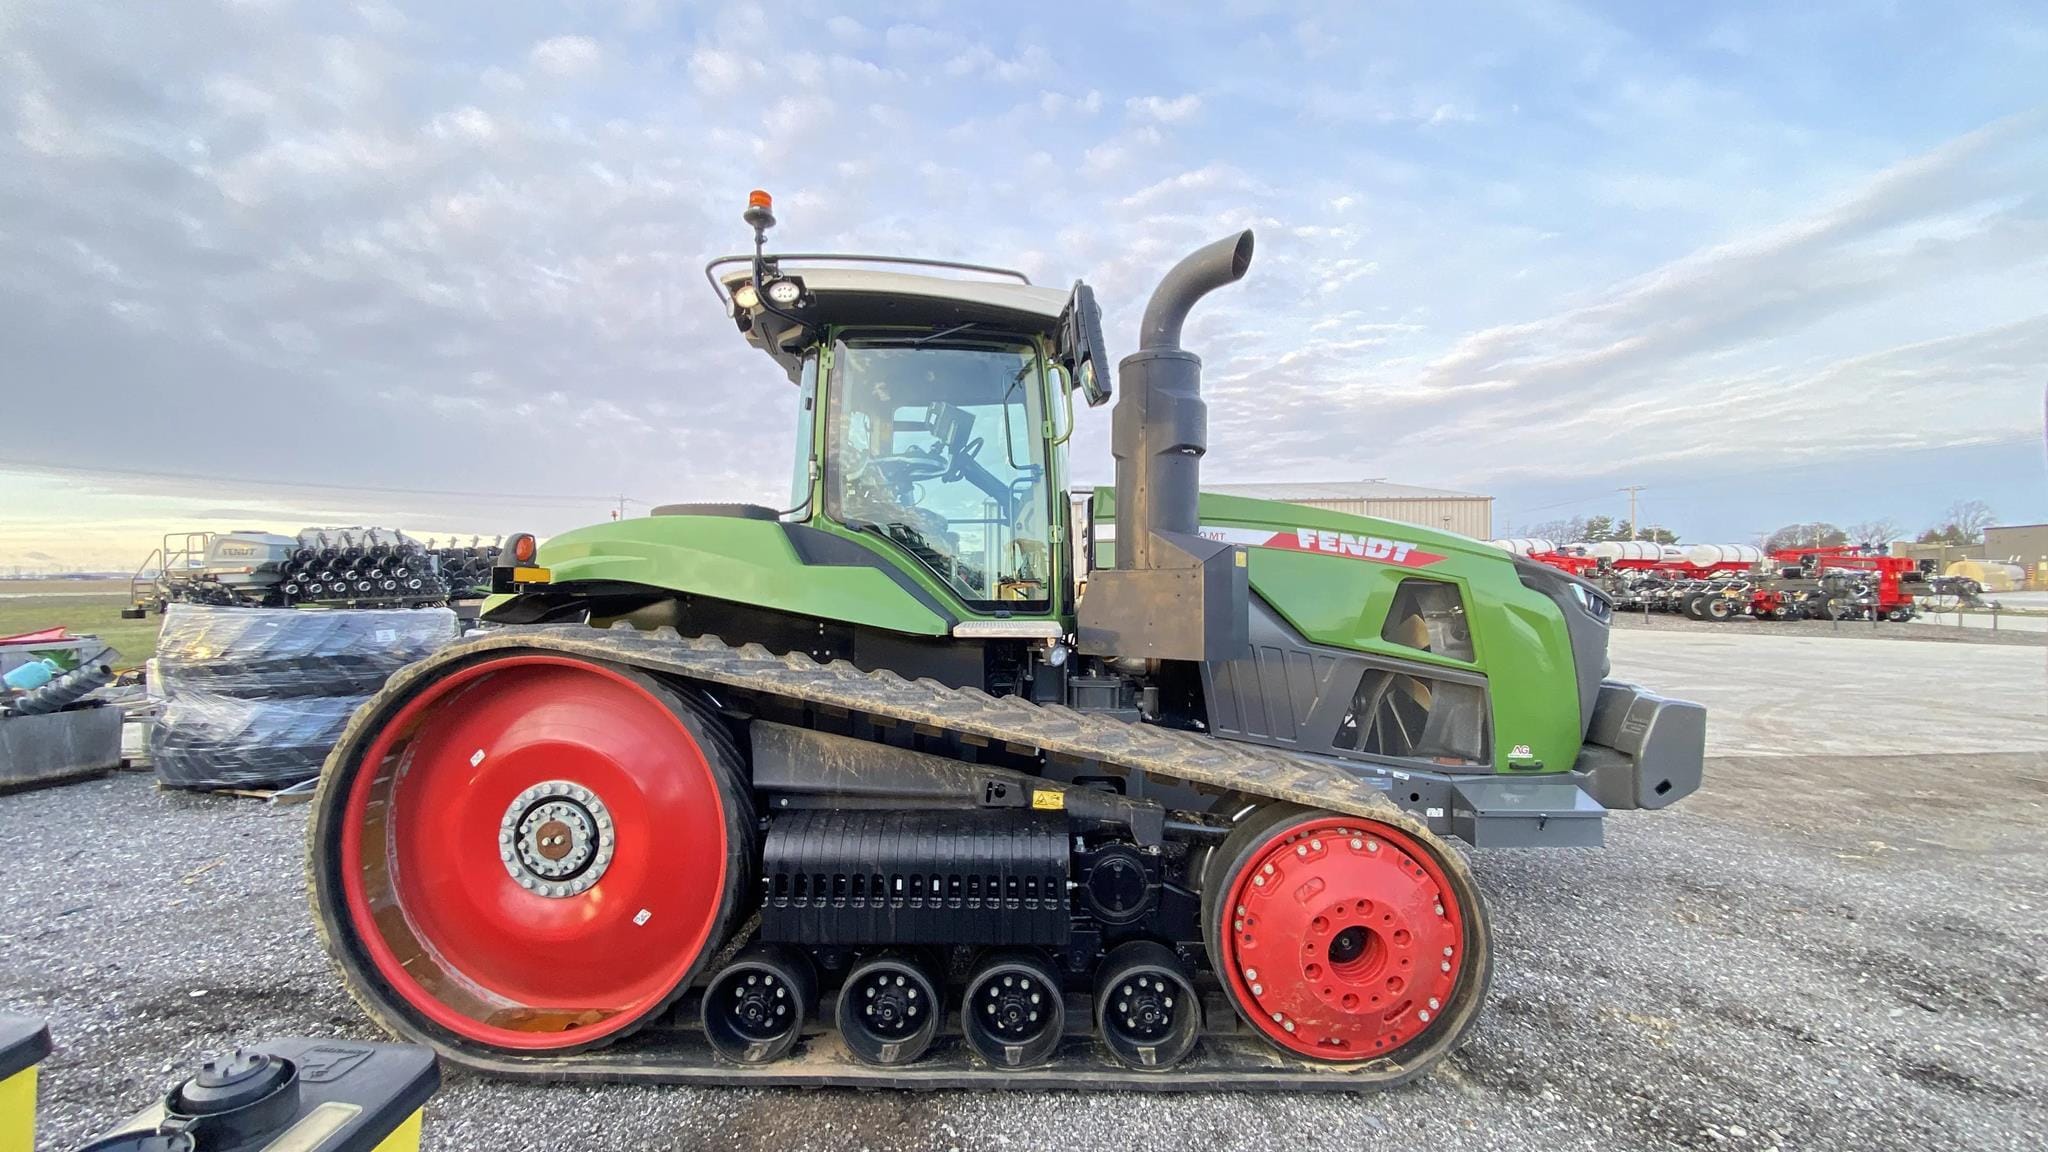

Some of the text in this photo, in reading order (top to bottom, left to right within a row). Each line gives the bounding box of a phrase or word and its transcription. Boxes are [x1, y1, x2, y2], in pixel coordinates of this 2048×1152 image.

[1210, 532, 1226, 541] MT
[1296, 528, 1418, 562] FENDT
[1513, 745, 1529, 755] AG
